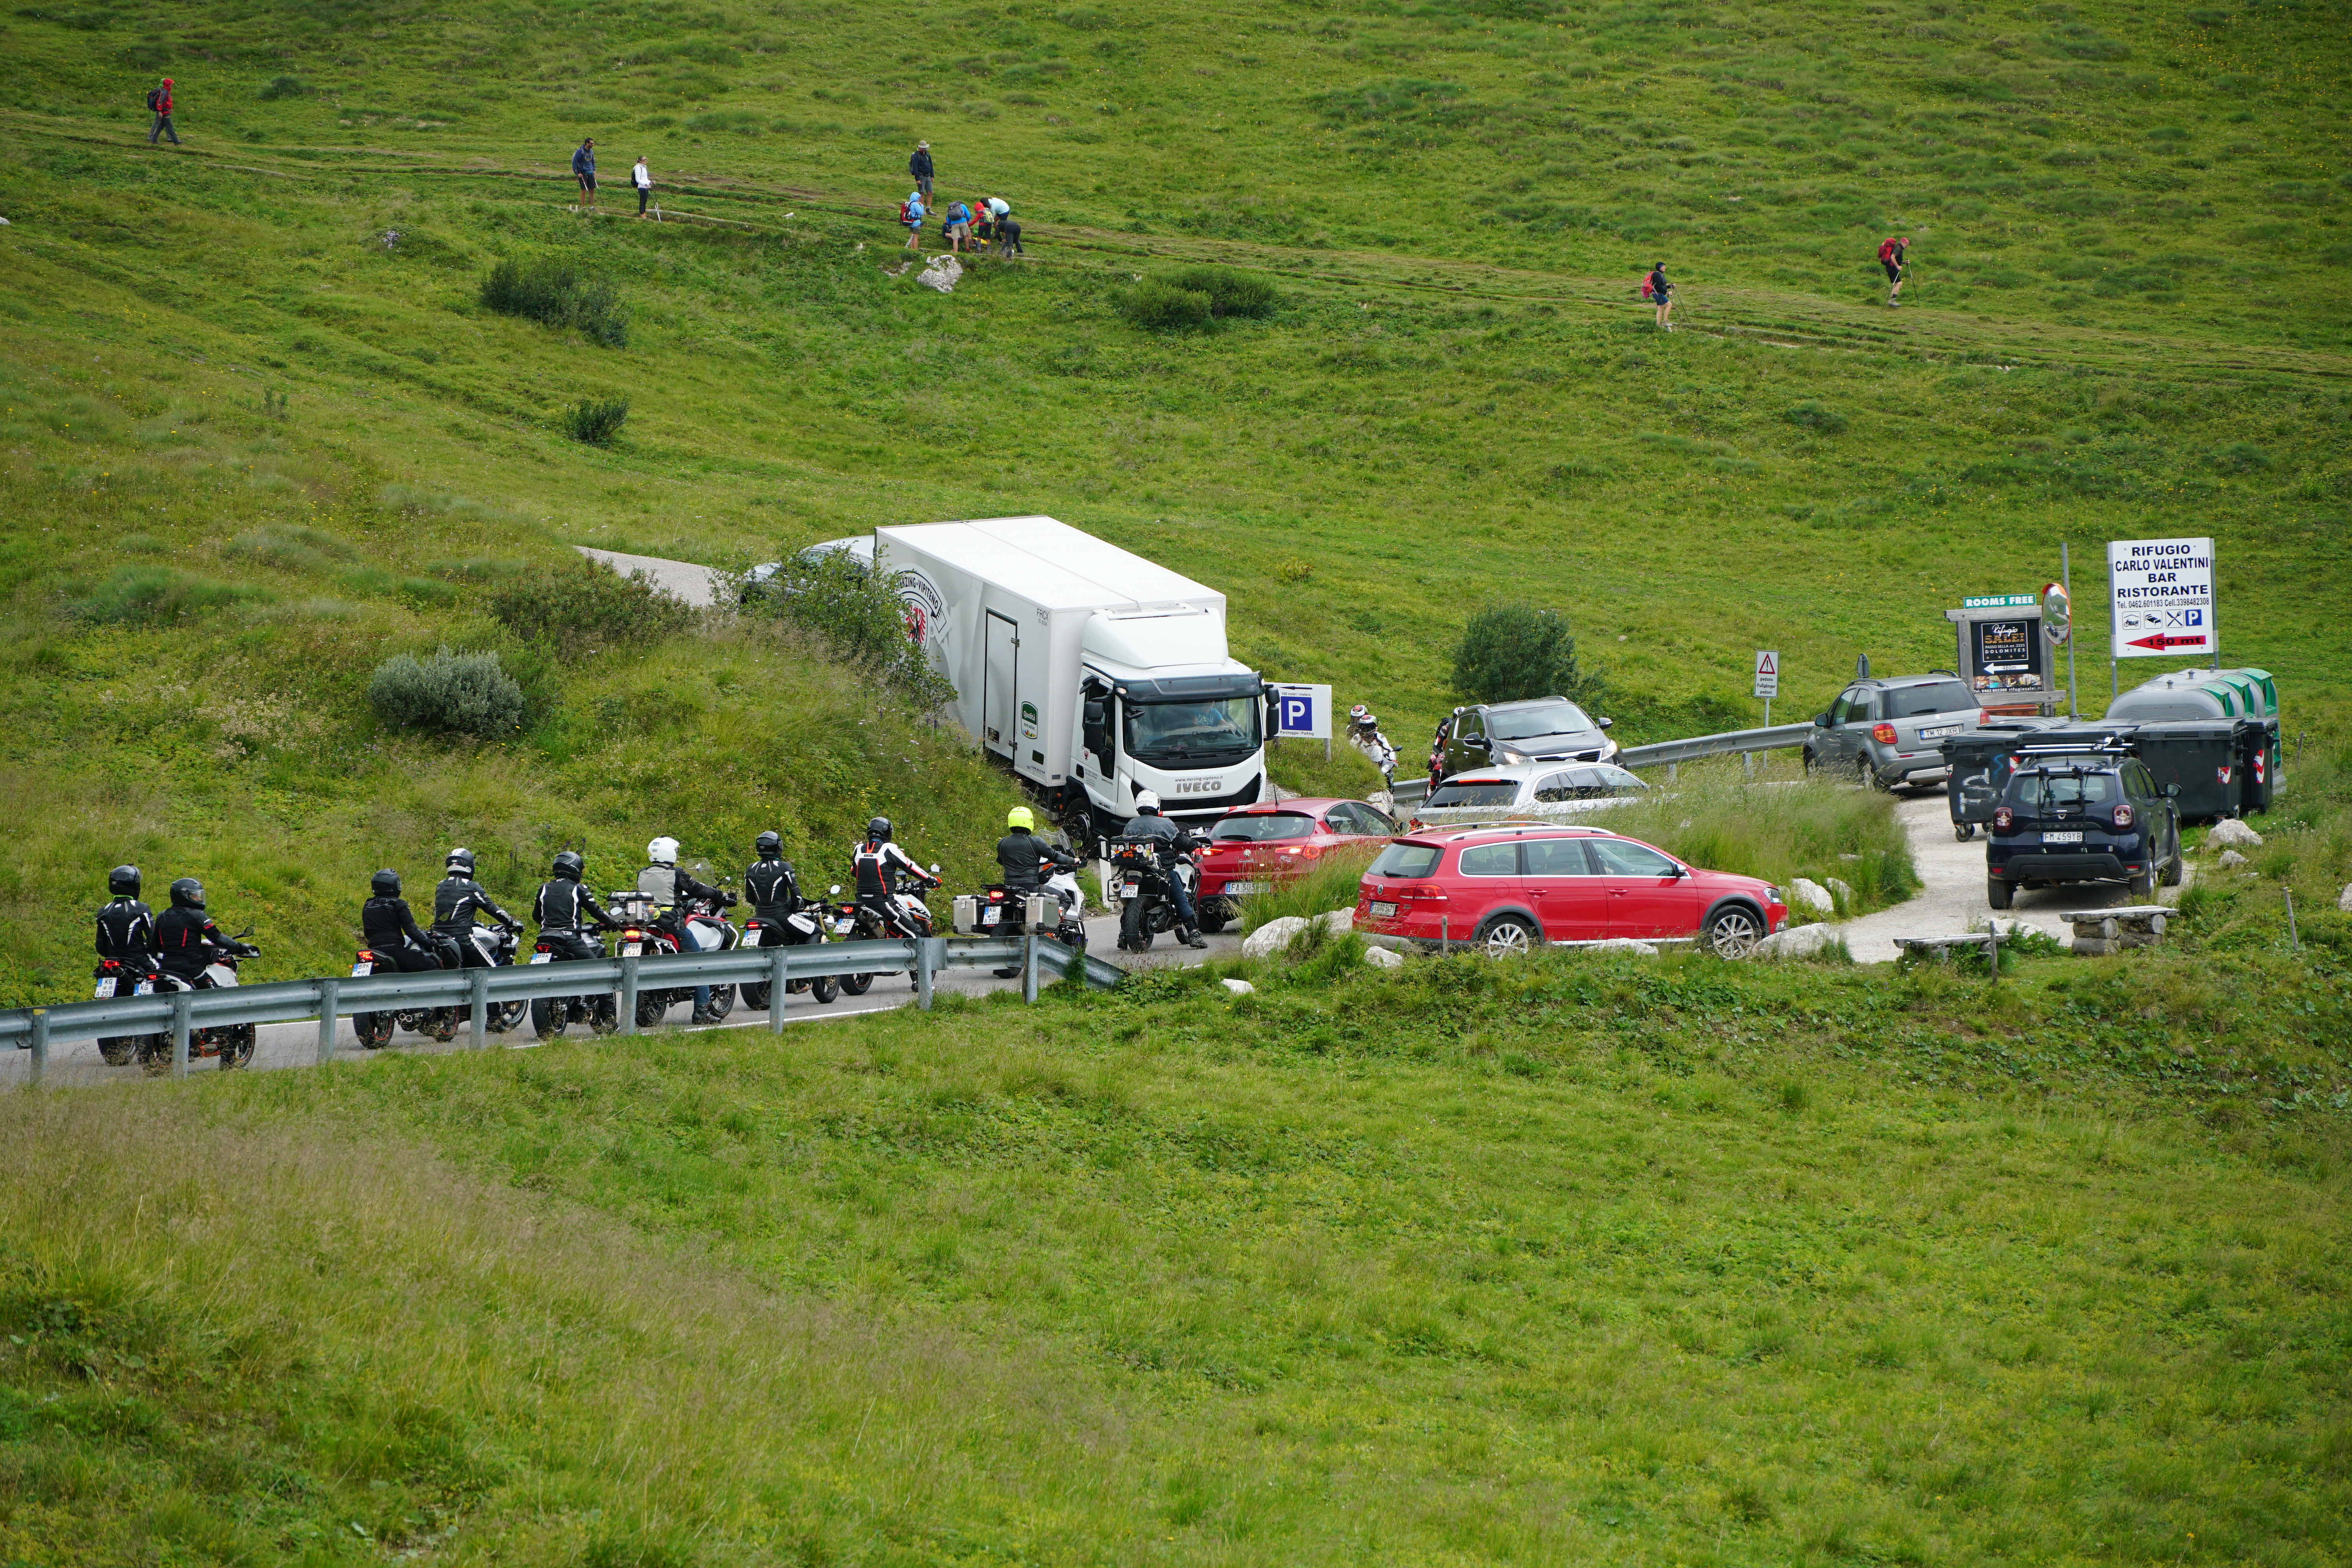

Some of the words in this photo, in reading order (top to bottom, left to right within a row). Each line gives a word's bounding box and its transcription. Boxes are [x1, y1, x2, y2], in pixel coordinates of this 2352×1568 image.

[2132, 545, 2190, 556] RIFUGIO
[2116, 559, 2150, 572] CARLO
[2153, 557, 2209, 570] VALENTINI
[2148, 572, 2177, 583] BAR
[918, 579, 938, 609] VIPITENO
[2118, 585, 2209, 598] RISTORANTE
[1966, 597, 2005, 606] ROOMS
[2009, 595, 2034, 604] FREE
[2129, 599, 2163, 608] 0462.601183
[2165, 597, 2209, 606] Cell.3398482308
[1037, 608, 1049, 621] FRCX
[2188, 611, 2199, 625] P
[1992, 624, 2018, 637] Rifugio
[1985, 633, 2025, 644] SALEI
[1288, 701, 1305, 726] P
[1176, 780, 1221, 793] IVECO
[2044, 833, 2054, 841] FM
[2057, 833, 2081, 841] 459YB
[793, 916, 811, 928] probiker
[476, 944, 492, 962] probiker
